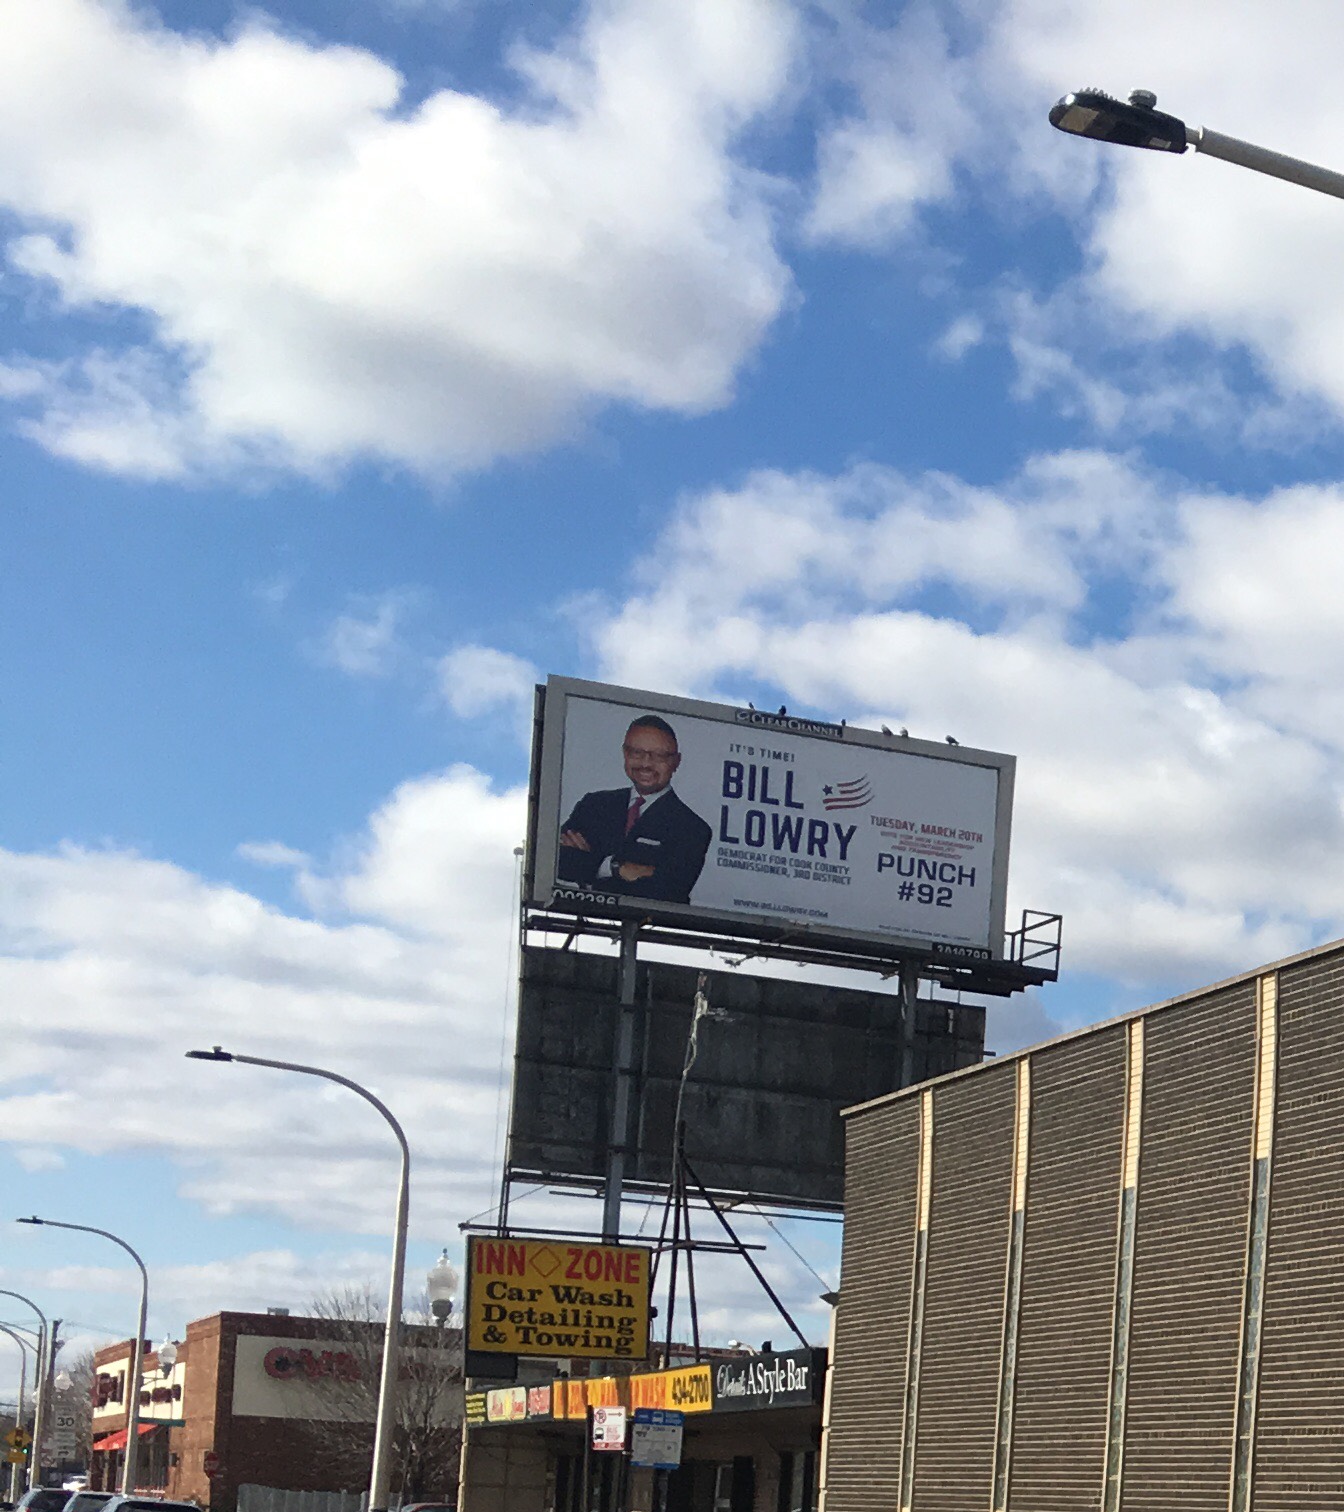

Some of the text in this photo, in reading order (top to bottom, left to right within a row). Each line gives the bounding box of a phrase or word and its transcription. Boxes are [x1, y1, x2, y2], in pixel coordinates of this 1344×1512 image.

[729, 743, 795, 762] IT'S TIME!
[722, 760, 805, 810] BILL
[719, 804, 857, 861] LOWRY
[870, 815, 983, 843] TUESDAY, MARCH 20TH
[717, 847, 850, 876] DEMOCRAT FOR COOK COUNTY
[717, 857, 790, 878] COMMISSIONER,
[813, 873, 852, 886] DISTRICT
[877, 852, 976, 888] PUNCH
[897, 880, 953, 908] #92
[476, 1242, 641, 1284] INN ZONE
[486, 1281, 634, 1308] Car Wash
[481, 1303, 637, 1335] Detailing
[483, 1324, 634, 1355] & Towing
[757, 1358, 787, 1404] Style
[787, 1358, 809, 1392] Bar
[57, 1417, 75, 1427] 30
